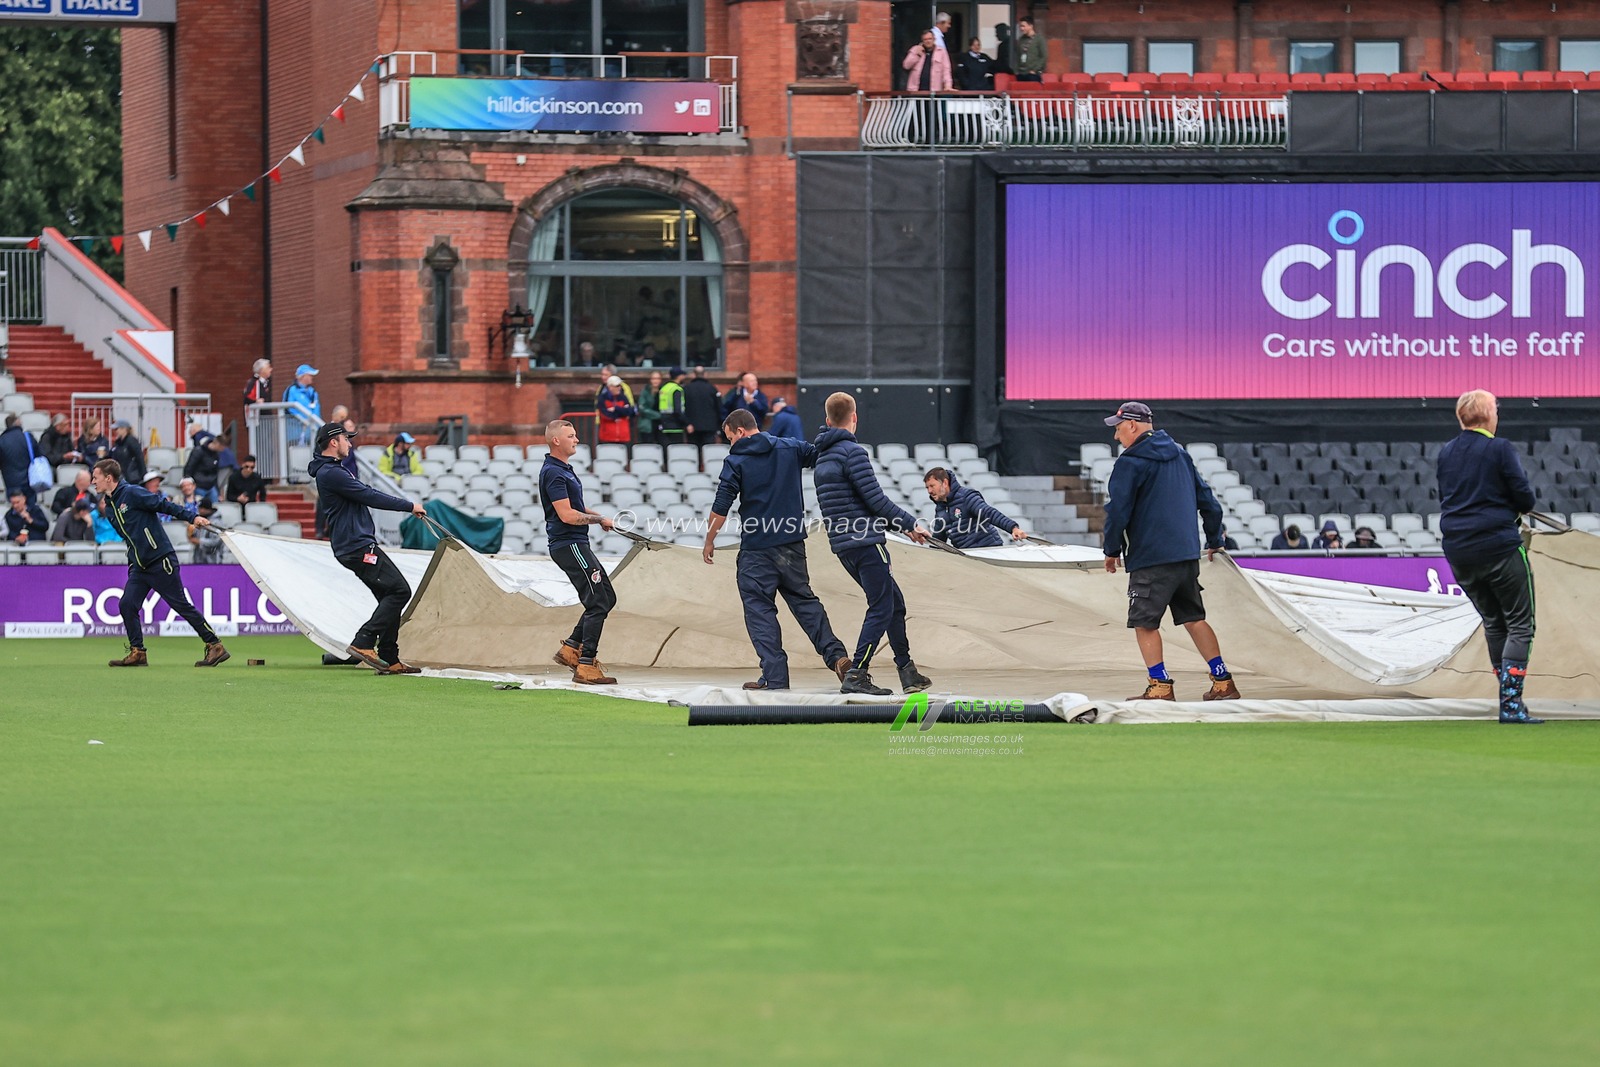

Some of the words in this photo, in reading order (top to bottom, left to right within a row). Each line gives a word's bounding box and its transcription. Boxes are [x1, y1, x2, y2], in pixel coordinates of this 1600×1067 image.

[66, 0, 134, 11] HARE
[487, 96, 644, 115] hilldickinson.com
[1261, 210, 1585, 320] cinch
[1262, 333, 1336, 358] Cars
[1344, 332, 1460, 357] without
[1468, 332, 1518, 357] the
[1526, 332, 1585, 357] faff
